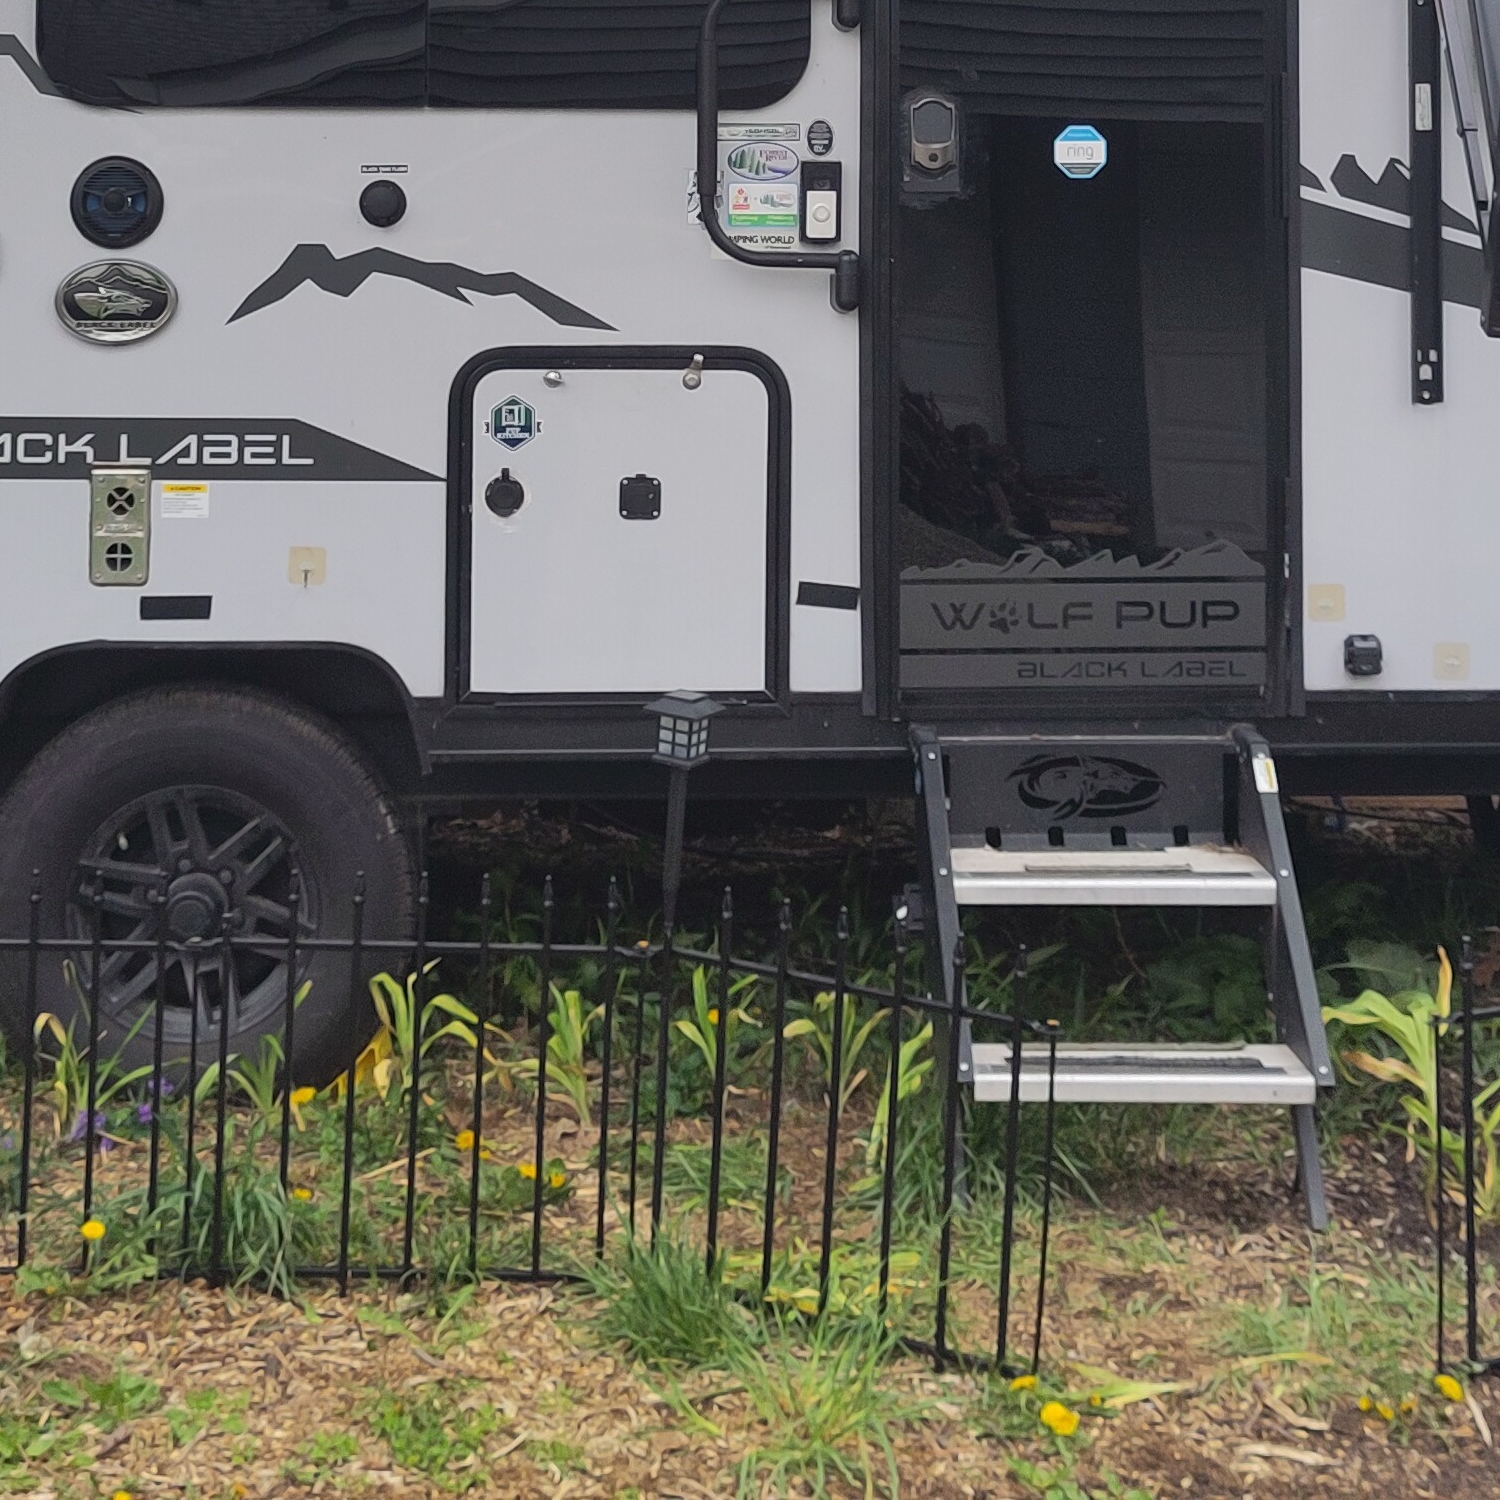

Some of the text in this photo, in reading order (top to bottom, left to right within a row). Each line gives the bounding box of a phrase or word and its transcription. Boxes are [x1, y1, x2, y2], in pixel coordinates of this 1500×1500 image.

[1066, 146, 1094, 161] ring
[760, 235, 795, 244] WORLD
[118, 433, 315, 465] LABEL
[1116, 600, 1240, 630] PUP
[1018, 659, 1247, 679] BLACK LABEL
